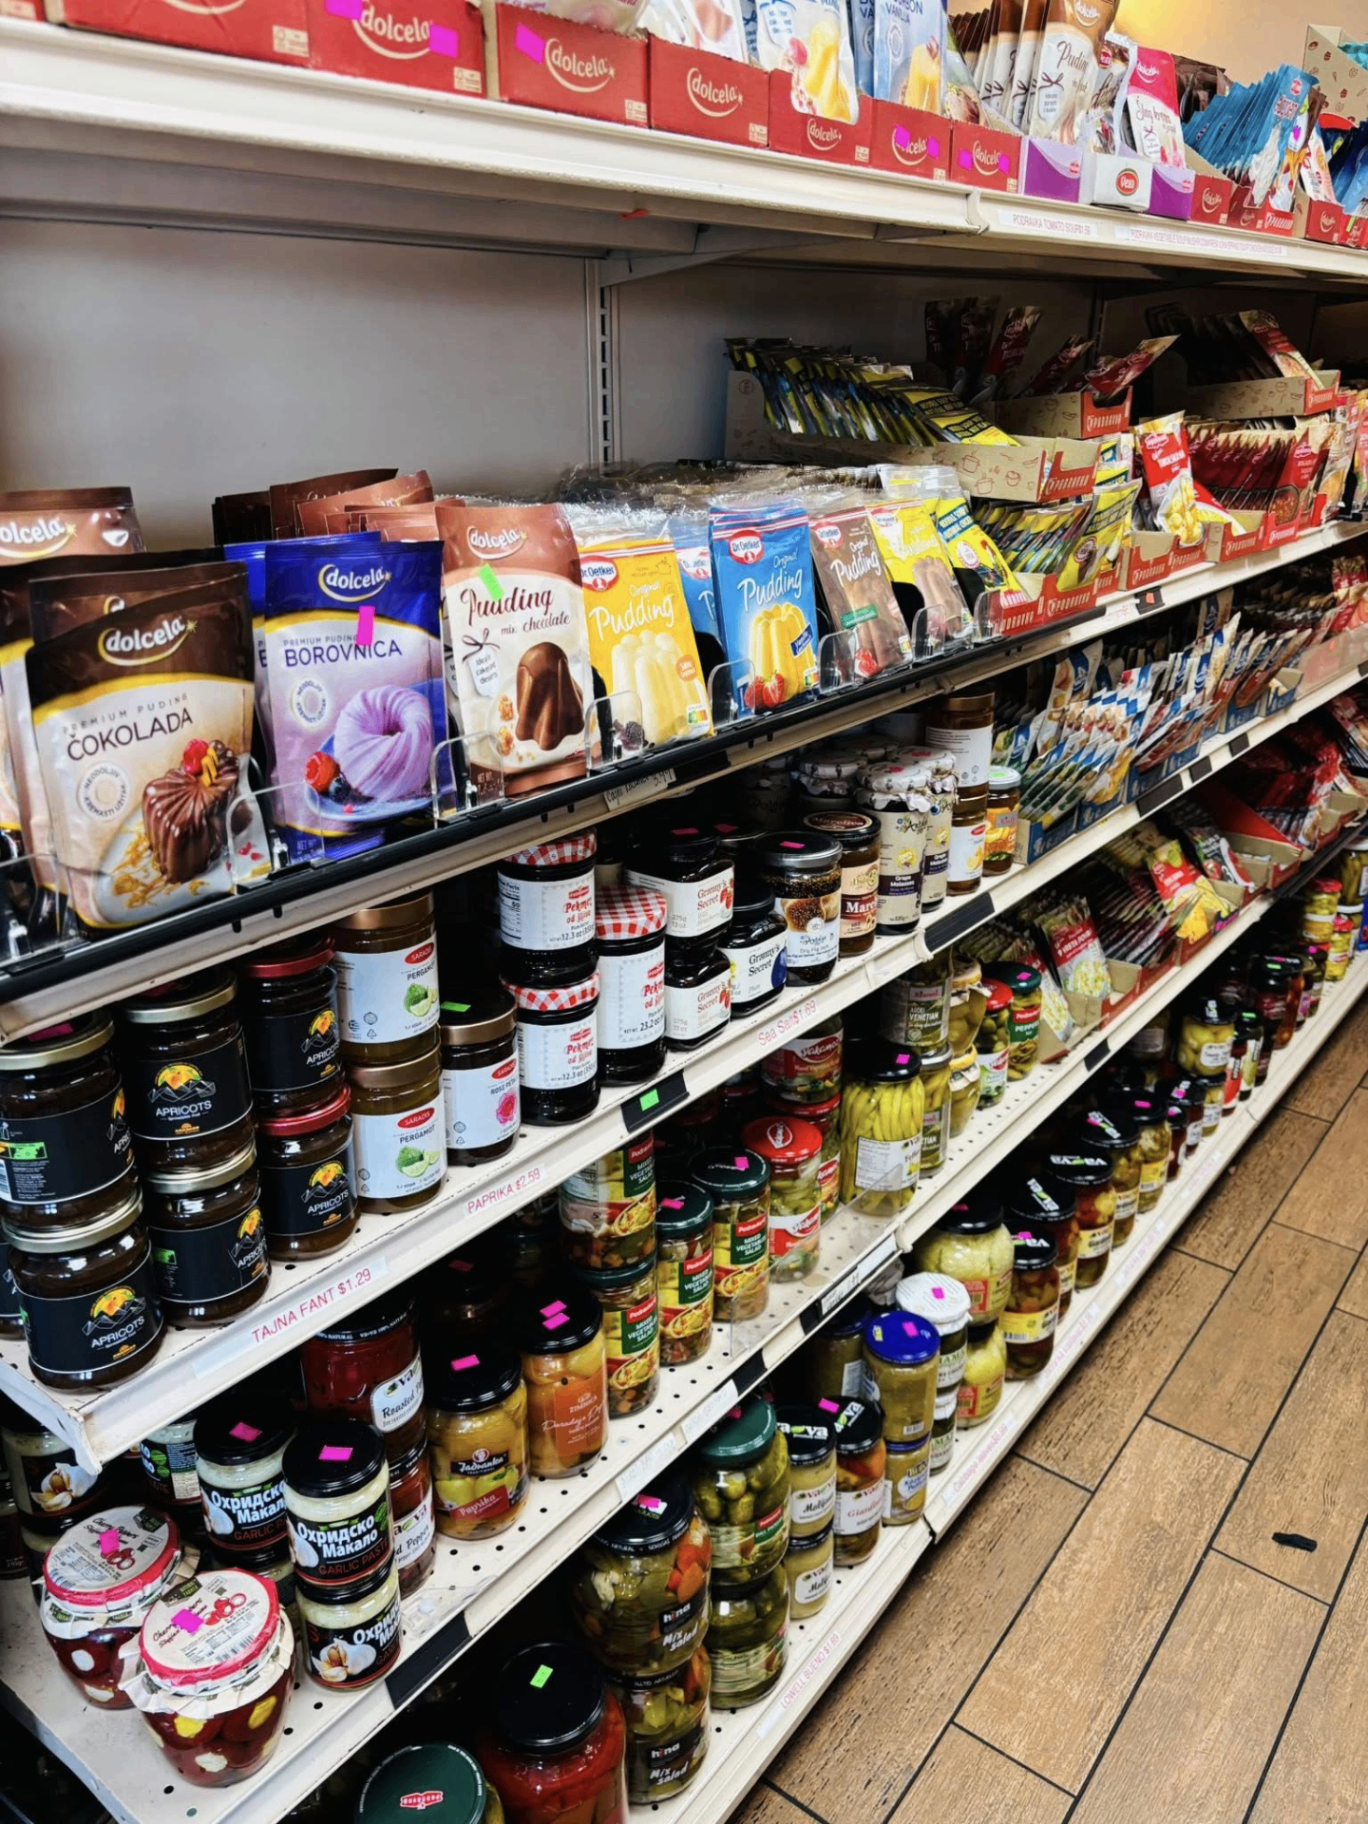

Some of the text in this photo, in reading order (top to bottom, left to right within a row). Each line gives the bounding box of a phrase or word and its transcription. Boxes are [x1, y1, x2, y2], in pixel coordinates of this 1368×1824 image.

[361, 5, 431, 43] dolcela
[550, 47, 609, 79] dolcela
[691, 76, 738, 104] dolcela
[0, 518, 65, 543] olcela
[470, 528, 520, 550] dolcela
[325, 565, 385, 591] dolcela
[830, 551, 880, 589] Pudding
[737, 568, 803, 614] Pudding
[522, 610, 571, 633] chocolate
[588, 594, 675, 642] Pudding
[105, 617, 186, 652] dolcela
[284, 637, 322, 646] PREMIUM
[284, 639, 403, 668] BOROVNICA
[63, 693, 188, 735] PREMIUM PUDING
[67, 707, 193, 761] ČOKOLADA
[697, 879, 727, 900] Granny's
[697, 894, 719, 911] Secret
[561, 931, 575, 941] 12.3
[748, 943, 781, 965] Granny's
[748, 959, 772, 977] Secret
[697, 995, 718, 1014] Secret
[640, 1018, 654, 1032] 23.2
[909, 1012, 939, 1021] VENETIAN
[758, 1028, 777, 1046] Sea
[562, 1072, 576, 1081] 12.3
[155, 1099, 213, 1117] APRICOTS
[404, 1111, 431, 1126] SARADIS
[399, 1124, 436, 1144] PERGAMOT
[307, 1189, 350, 1215] APRICOTS
[467, 1167, 541, 1214] PAPRIKA $2.59
[251, 1268, 372, 1343] TAJNA FANT $1.29
[91, 1315, 145, 1349] APRICOTS
[381, 1389, 416, 1419] Roasted
[805, 1425, 829, 1438] va
[458, 1456, 504, 1473] Jadranka
[236, 1497, 287, 1525] Макал
[458, 1492, 499, 1517] Paprika
[233, 1520, 273, 1541] GARLIC
[297, 1514, 375, 1548] Охридско
[322, 1529, 378, 1559] Макало
[318, 1560, 360, 1576] GARLIC
[663, 1603, 691, 1623] hina
[662, 1629, 684, 1647] Mix
[670, 1622, 698, 1652] salad
[780, 1651, 826, 1709] LOWELL BUENO
[651, 1742, 680, 1758] hina
[650, 1767, 671, 1780] Mix
[657, 1762, 688, 1785] salad
